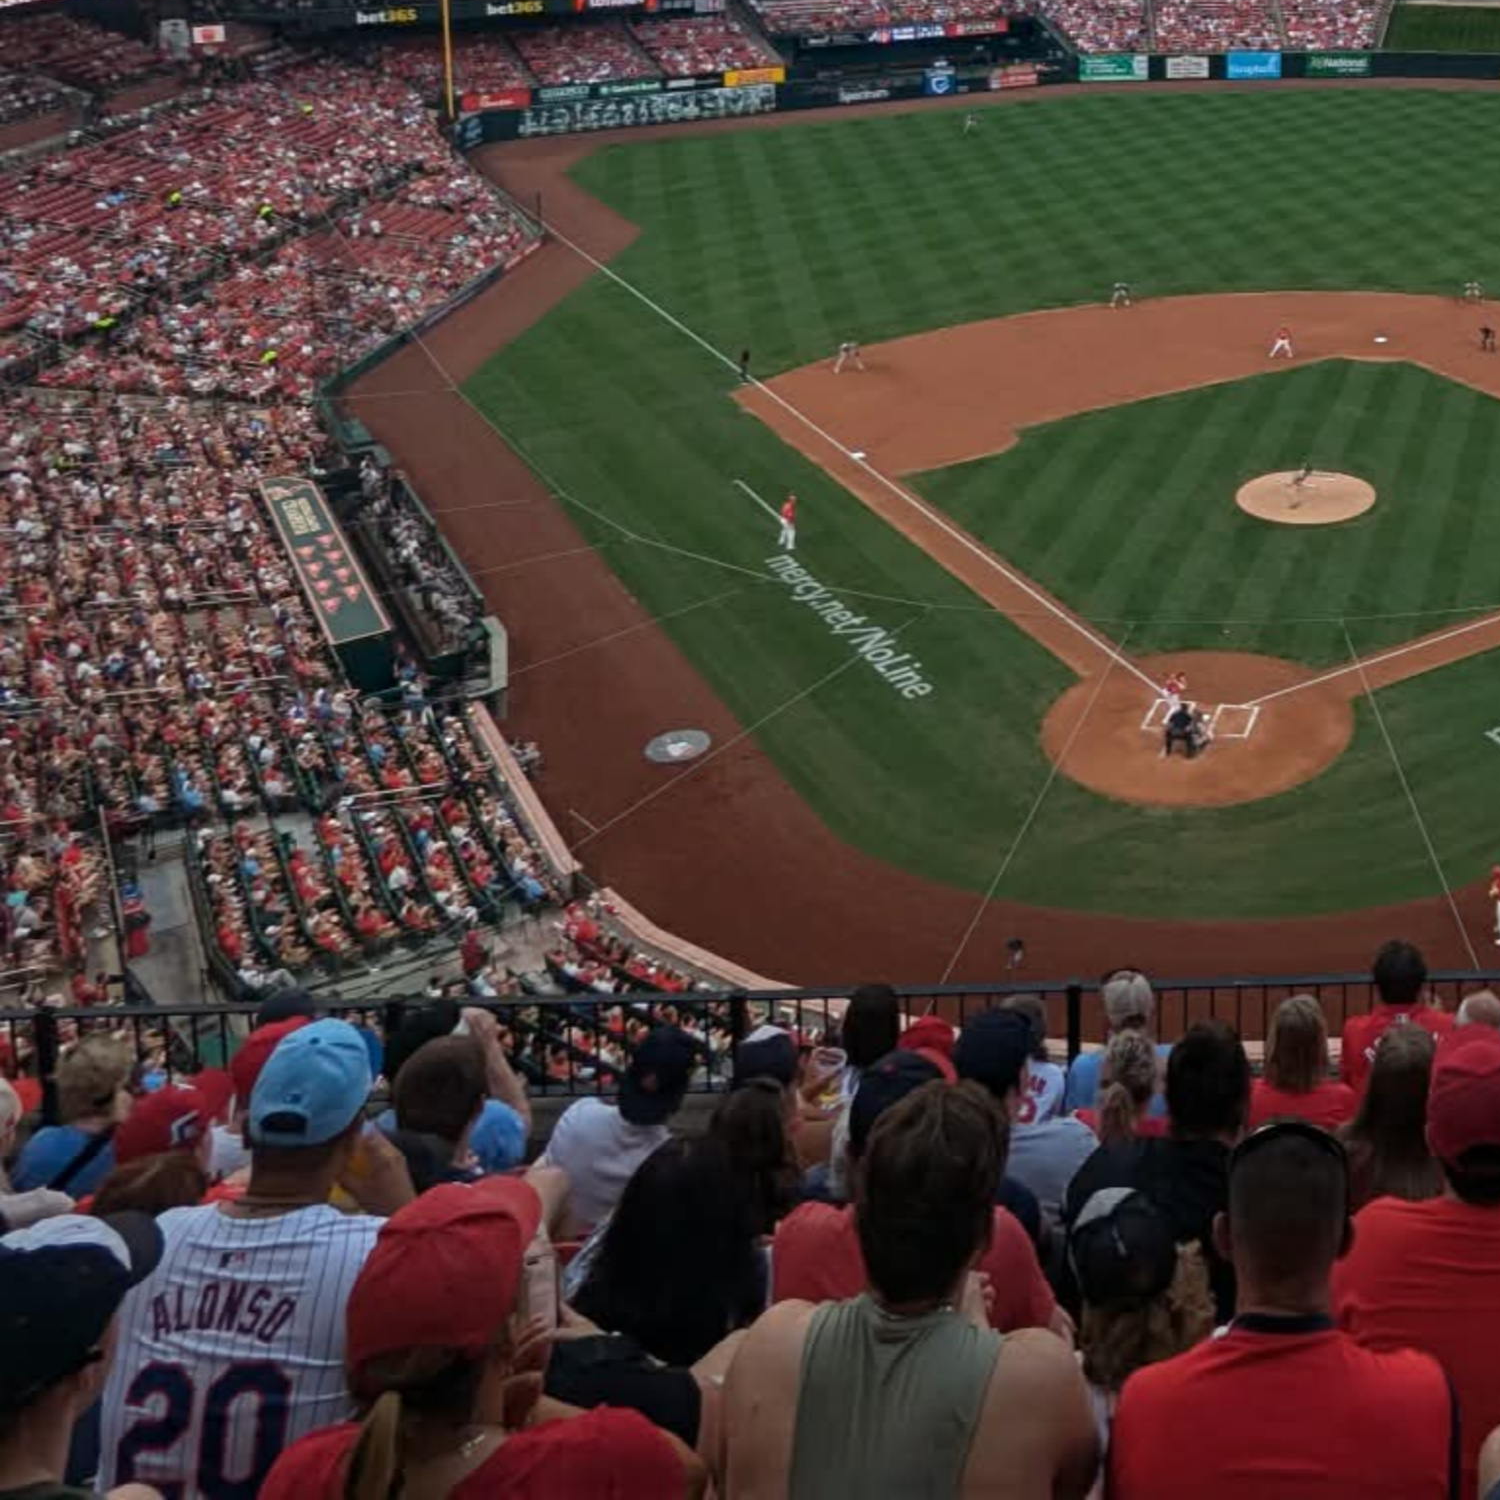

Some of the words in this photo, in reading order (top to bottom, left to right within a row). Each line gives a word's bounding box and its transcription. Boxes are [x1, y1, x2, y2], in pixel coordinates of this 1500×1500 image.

[356, 7, 418, 24] bet365
[486, 0, 544, 16] bet365
[764, 554, 933, 699] mercy.net/NoLine
[150, 1281, 298, 1344] ALONSO
[115, 1360, 293, 1500] 20
